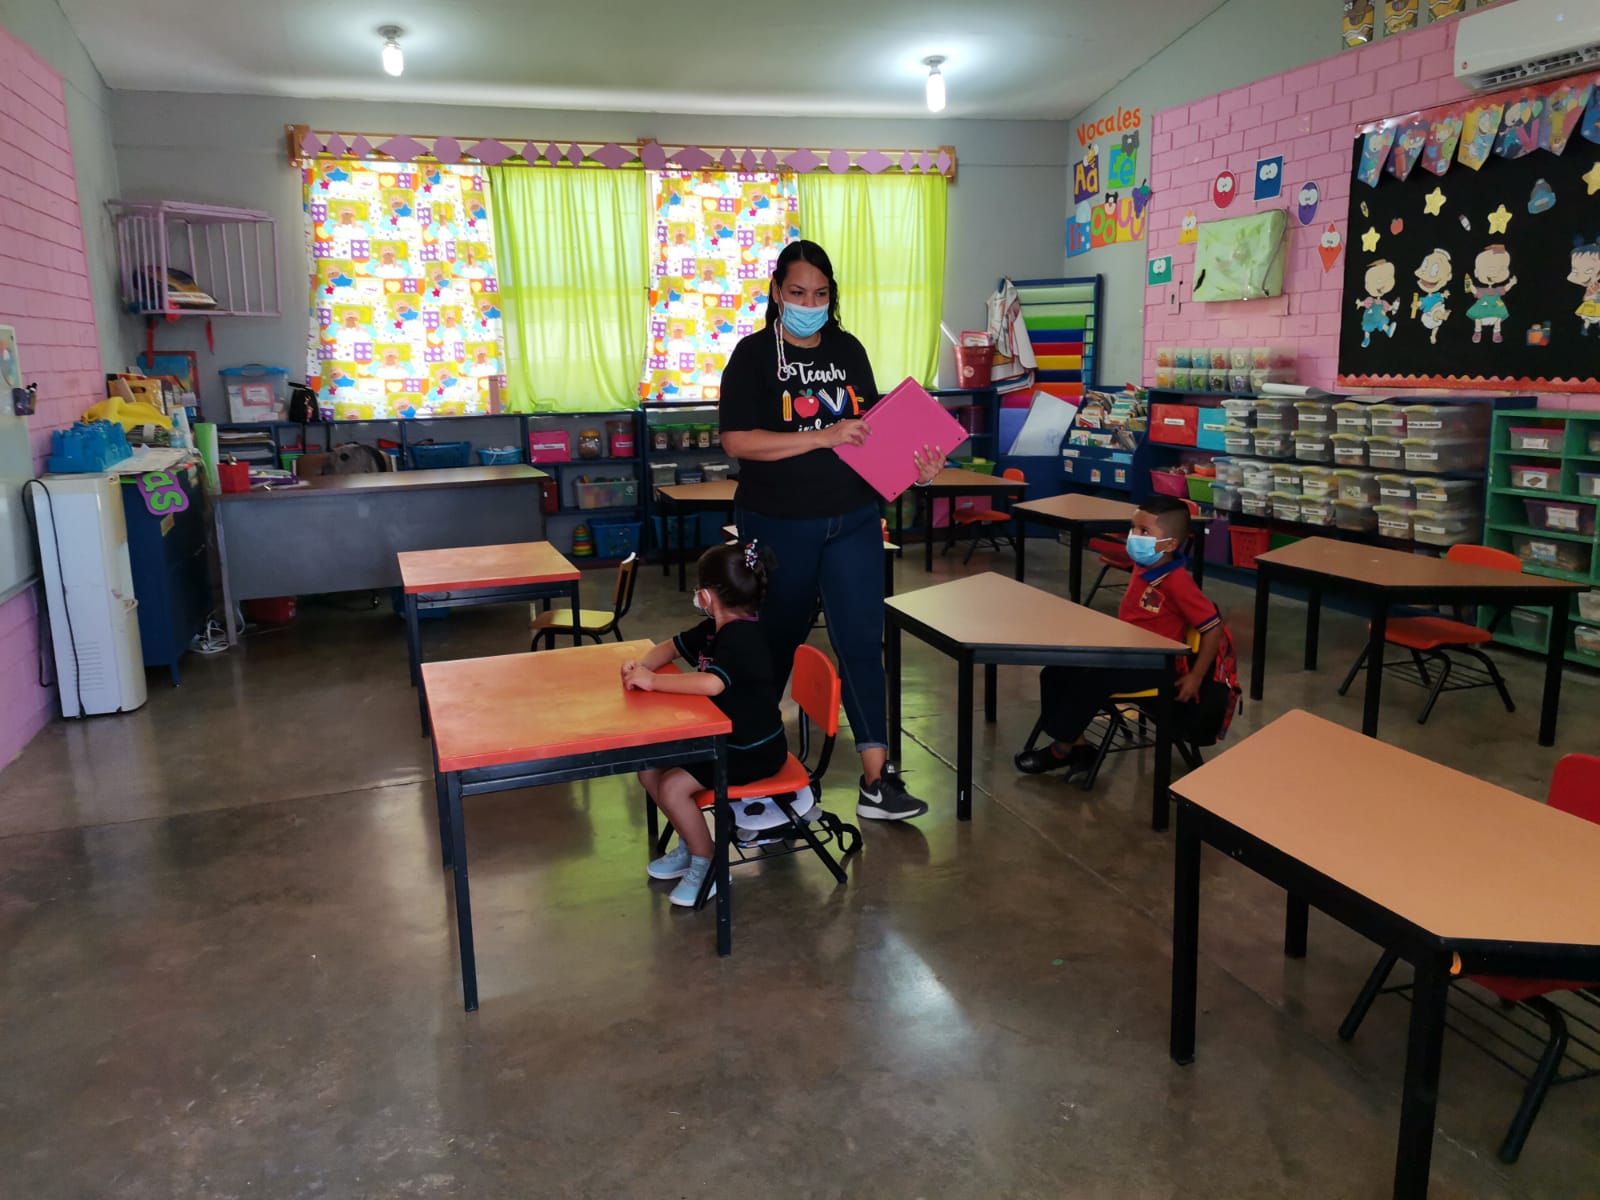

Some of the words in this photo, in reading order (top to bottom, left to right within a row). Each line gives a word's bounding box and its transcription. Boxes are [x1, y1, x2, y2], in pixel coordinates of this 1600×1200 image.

[1076, 106, 1142, 147] Vocales
[1074, 162, 1098, 195] Aa
[1109, 149, 1135, 185] Ee
[1091, 207, 1116, 243] Oo
[784, 361, 847, 385] Teach
